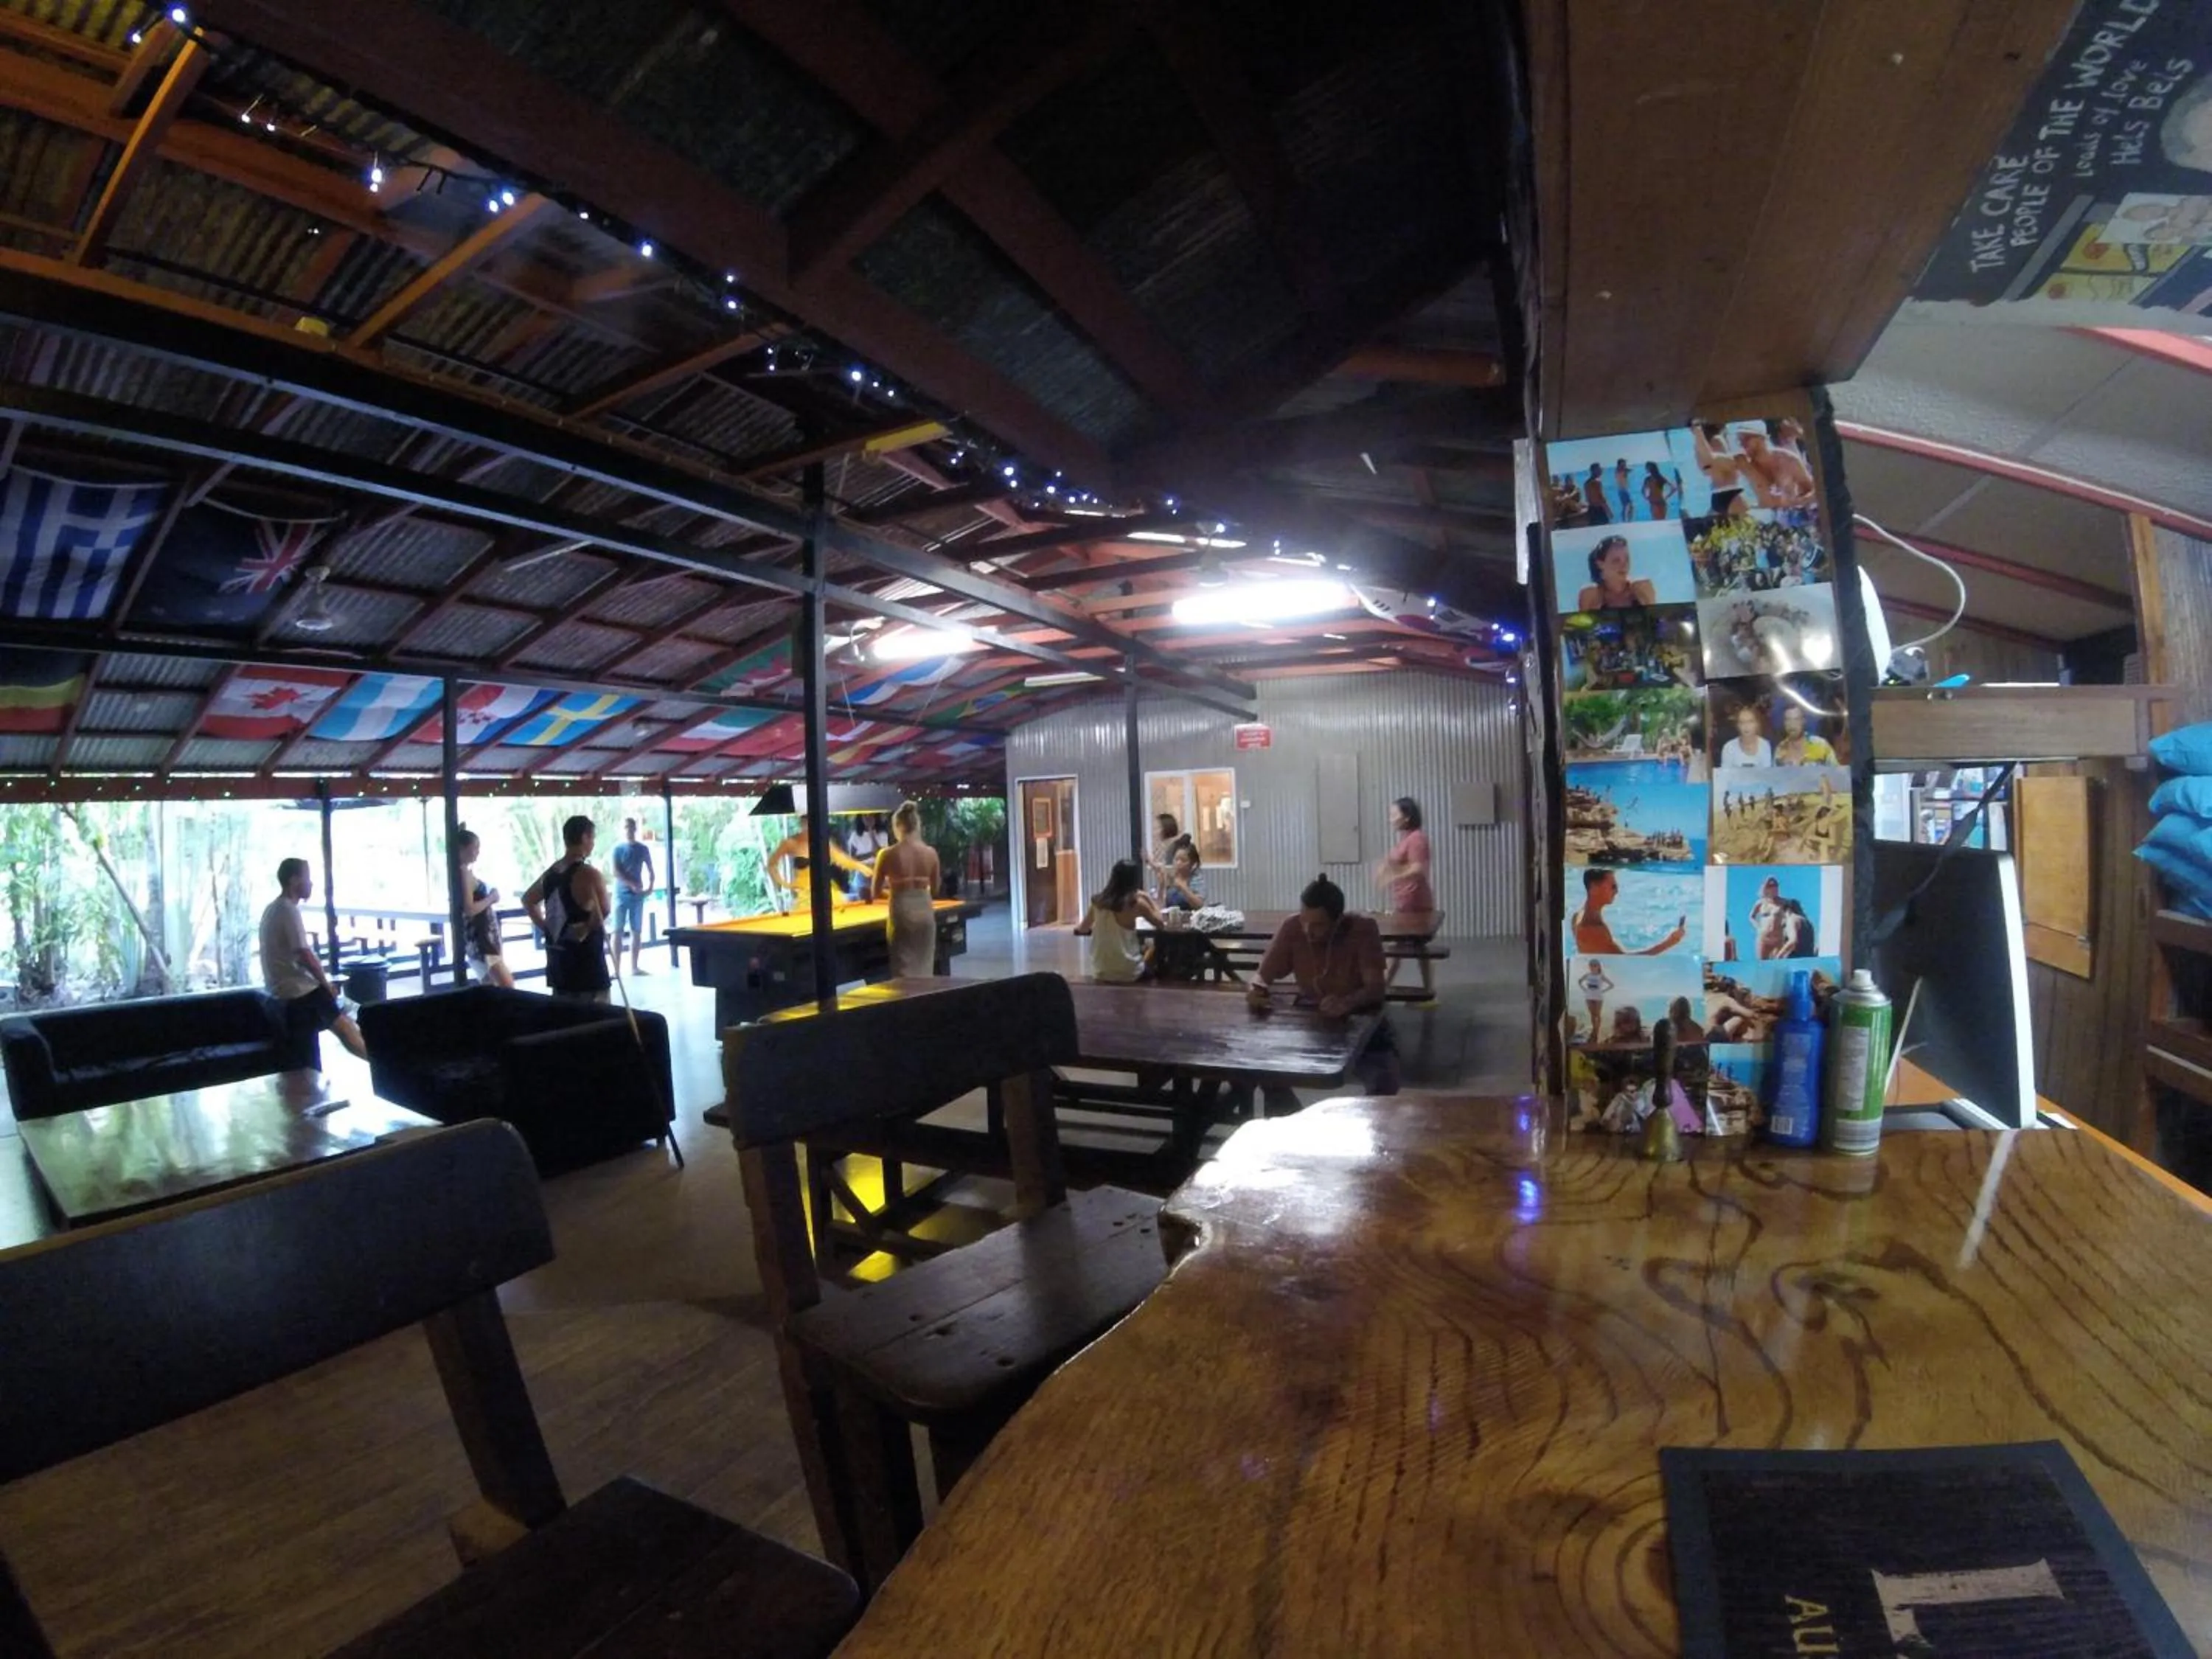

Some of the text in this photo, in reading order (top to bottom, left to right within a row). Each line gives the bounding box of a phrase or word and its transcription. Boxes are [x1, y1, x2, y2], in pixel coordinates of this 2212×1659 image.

[2038, 98, 2084, 140] THE
[2033, 147, 2060, 174] OF
[1969, 153, 2028, 274] TAKE CARE
[2010, 184, 2051, 248] PEOPLE
